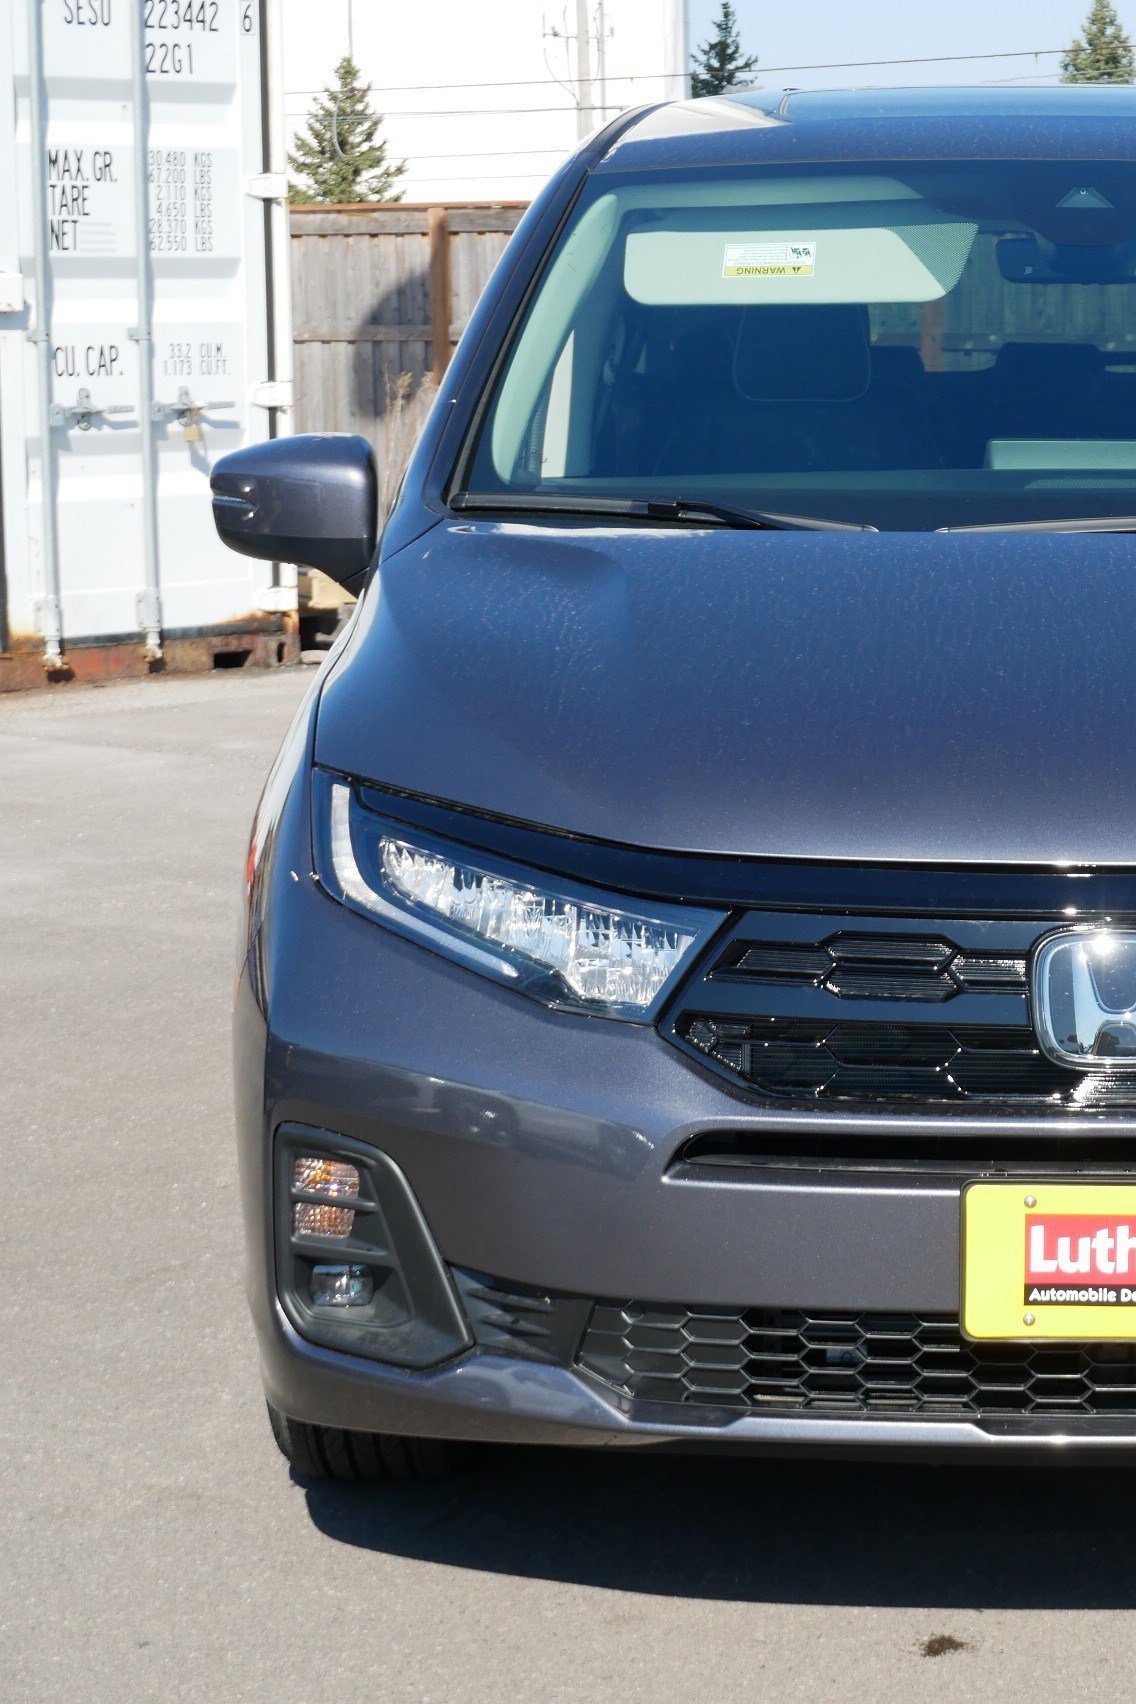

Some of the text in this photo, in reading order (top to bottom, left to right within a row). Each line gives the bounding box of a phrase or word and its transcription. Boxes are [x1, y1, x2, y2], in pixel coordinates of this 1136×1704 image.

[64, 0, 252, 33] SESU 223442 6
[145, 43, 193, 74] 22G1
[194, 152, 212, 168] KGS
[194, 169, 212, 185] LBS
[49, 184, 90, 216] TARE
[194, 186, 212, 202] KGS
[194, 202, 212, 218] LBS
[50, 219, 79, 251] NET
[195, 219, 213, 235] KGS
[195, 236, 213, 252] LBS
[736, 266, 786, 275] WARNING
[86, 344, 123, 377] CAP.
[1028, 1287, 1117, 1303] Automobile
